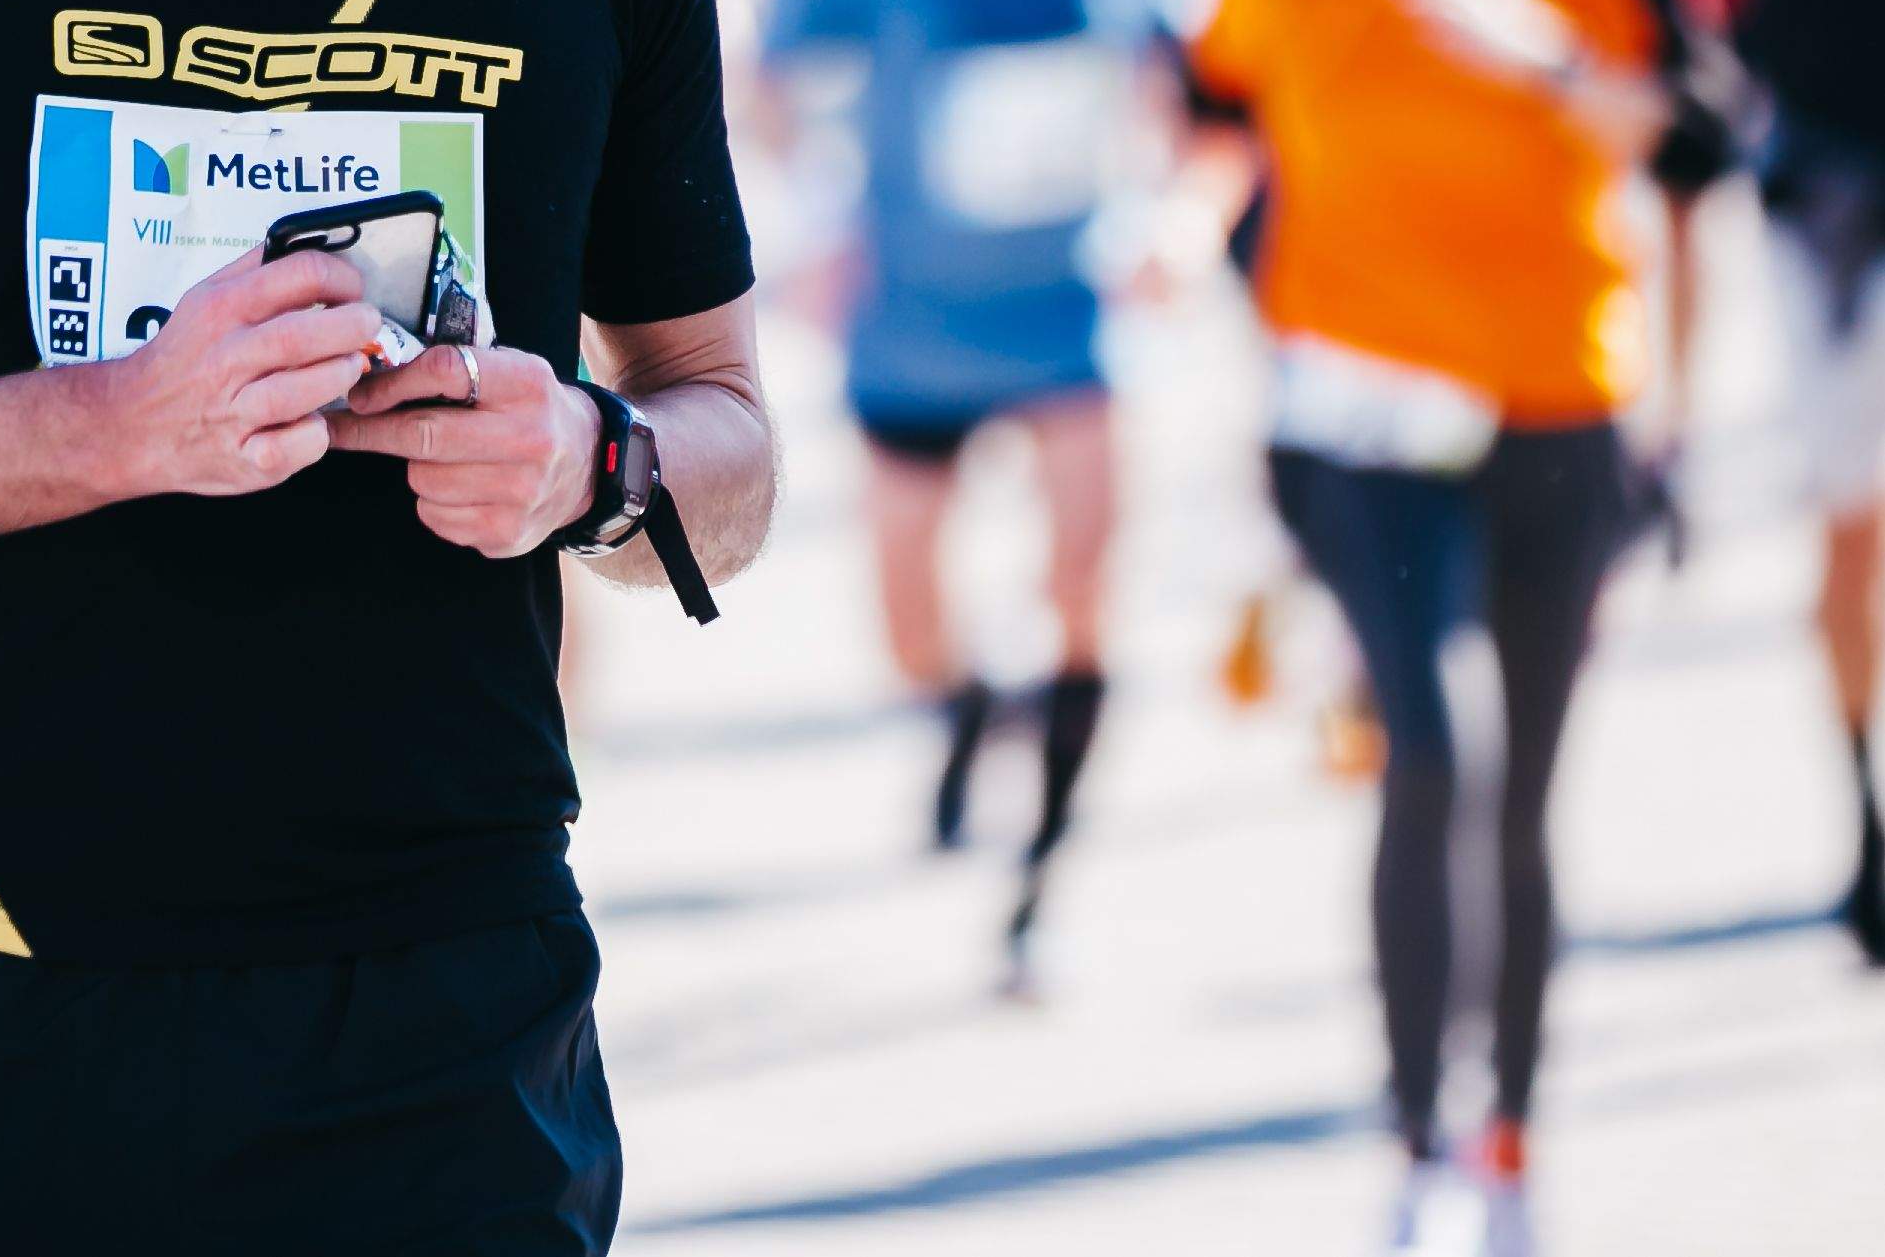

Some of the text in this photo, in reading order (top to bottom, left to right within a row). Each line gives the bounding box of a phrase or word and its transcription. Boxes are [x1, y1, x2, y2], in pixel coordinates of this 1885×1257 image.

[179, 29, 519, 102] SCOTT
[207, 153, 380, 193] MetLife
[133, 217, 173, 245] VIII
